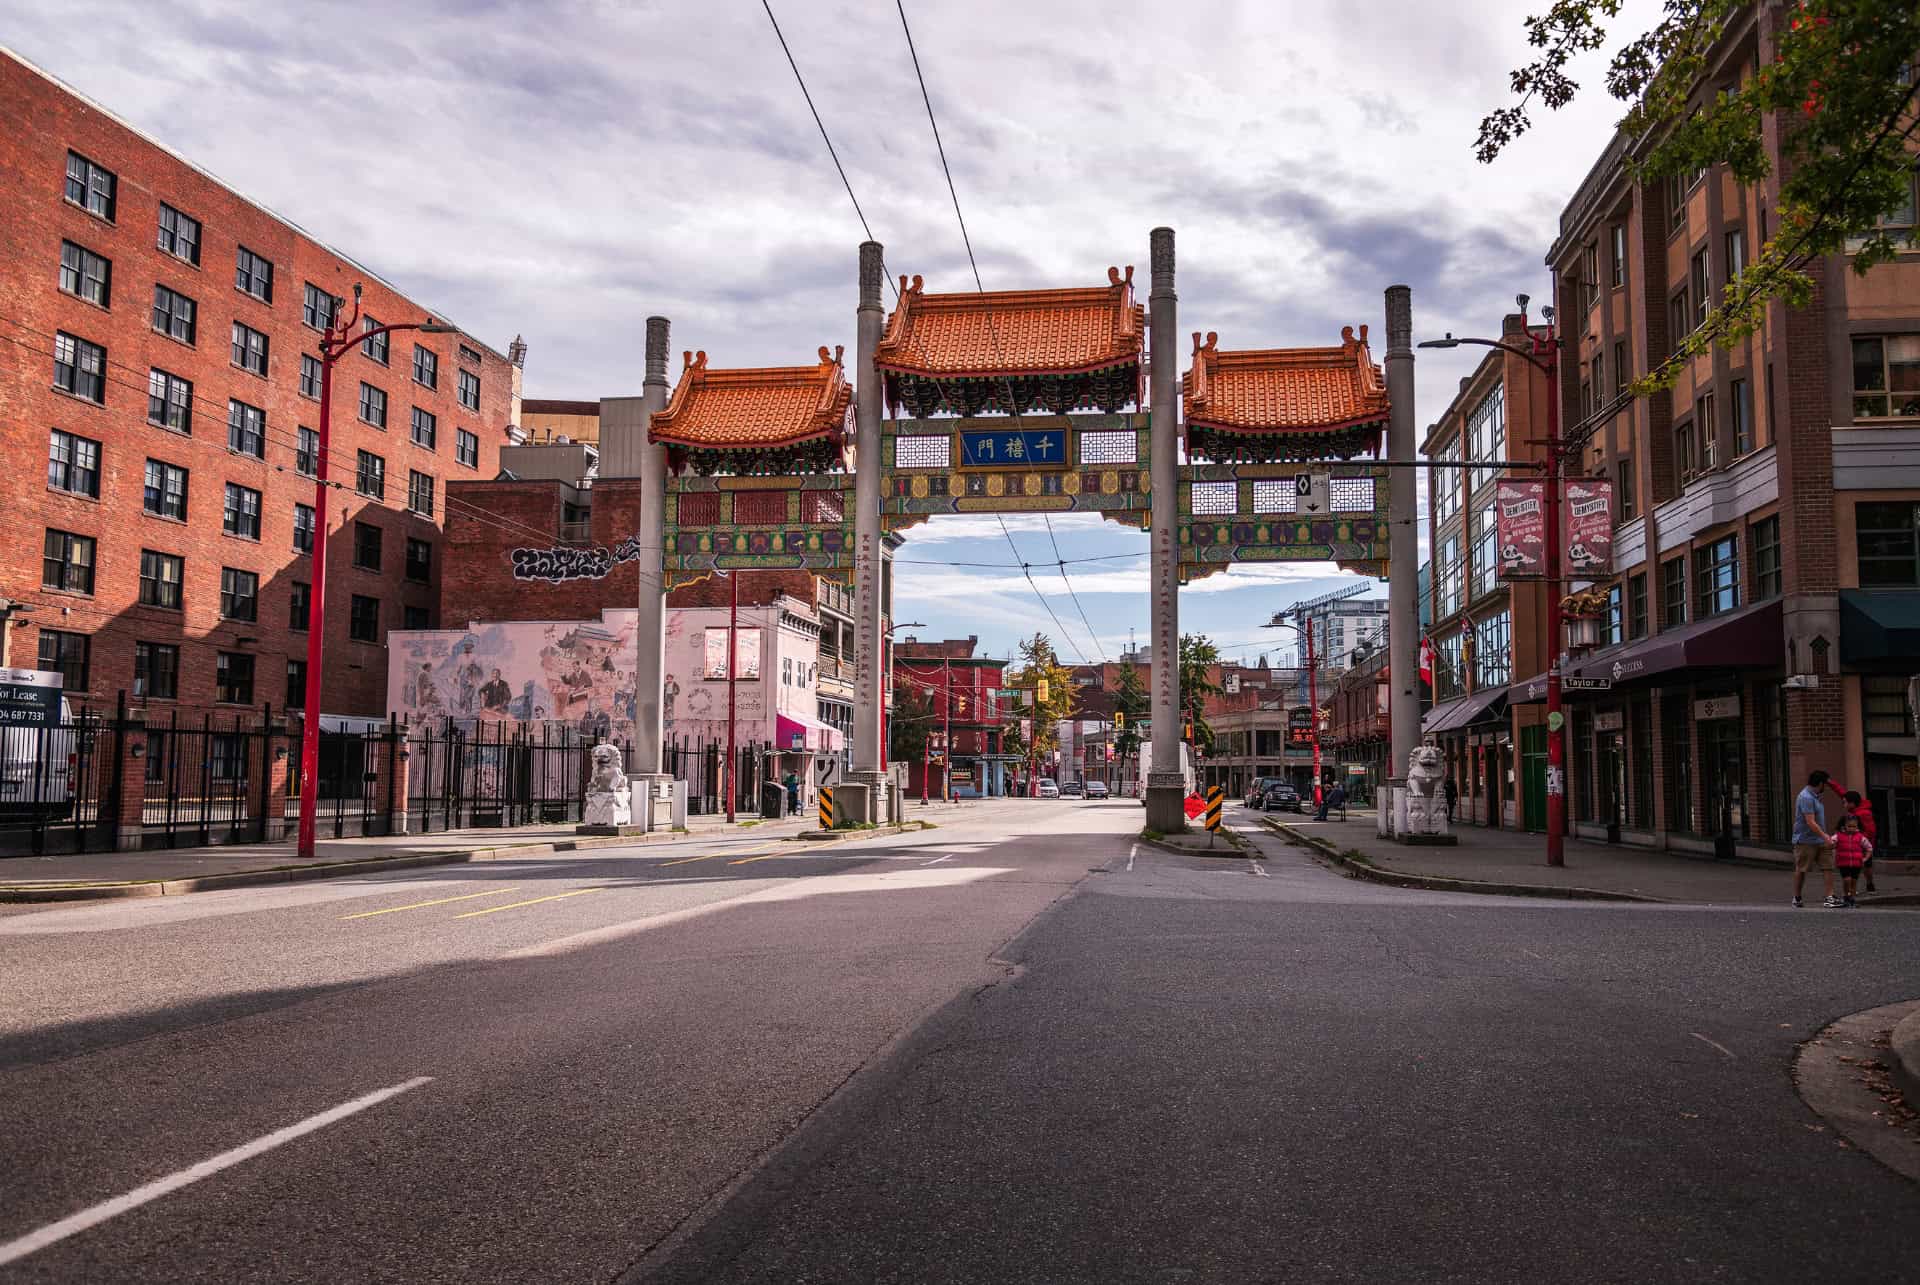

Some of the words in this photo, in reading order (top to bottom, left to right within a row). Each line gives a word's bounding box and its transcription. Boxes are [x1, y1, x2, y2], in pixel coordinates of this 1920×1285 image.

[1574, 500, 1606, 515] DEMYSTIFY
[1568, 679, 1595, 687] Taylor
[0, 688, 9, 699] or
[13, 688, 38, 701] Lease
[11, 710, 27, 720] 687
[28, 711, 45, 721] 7331
